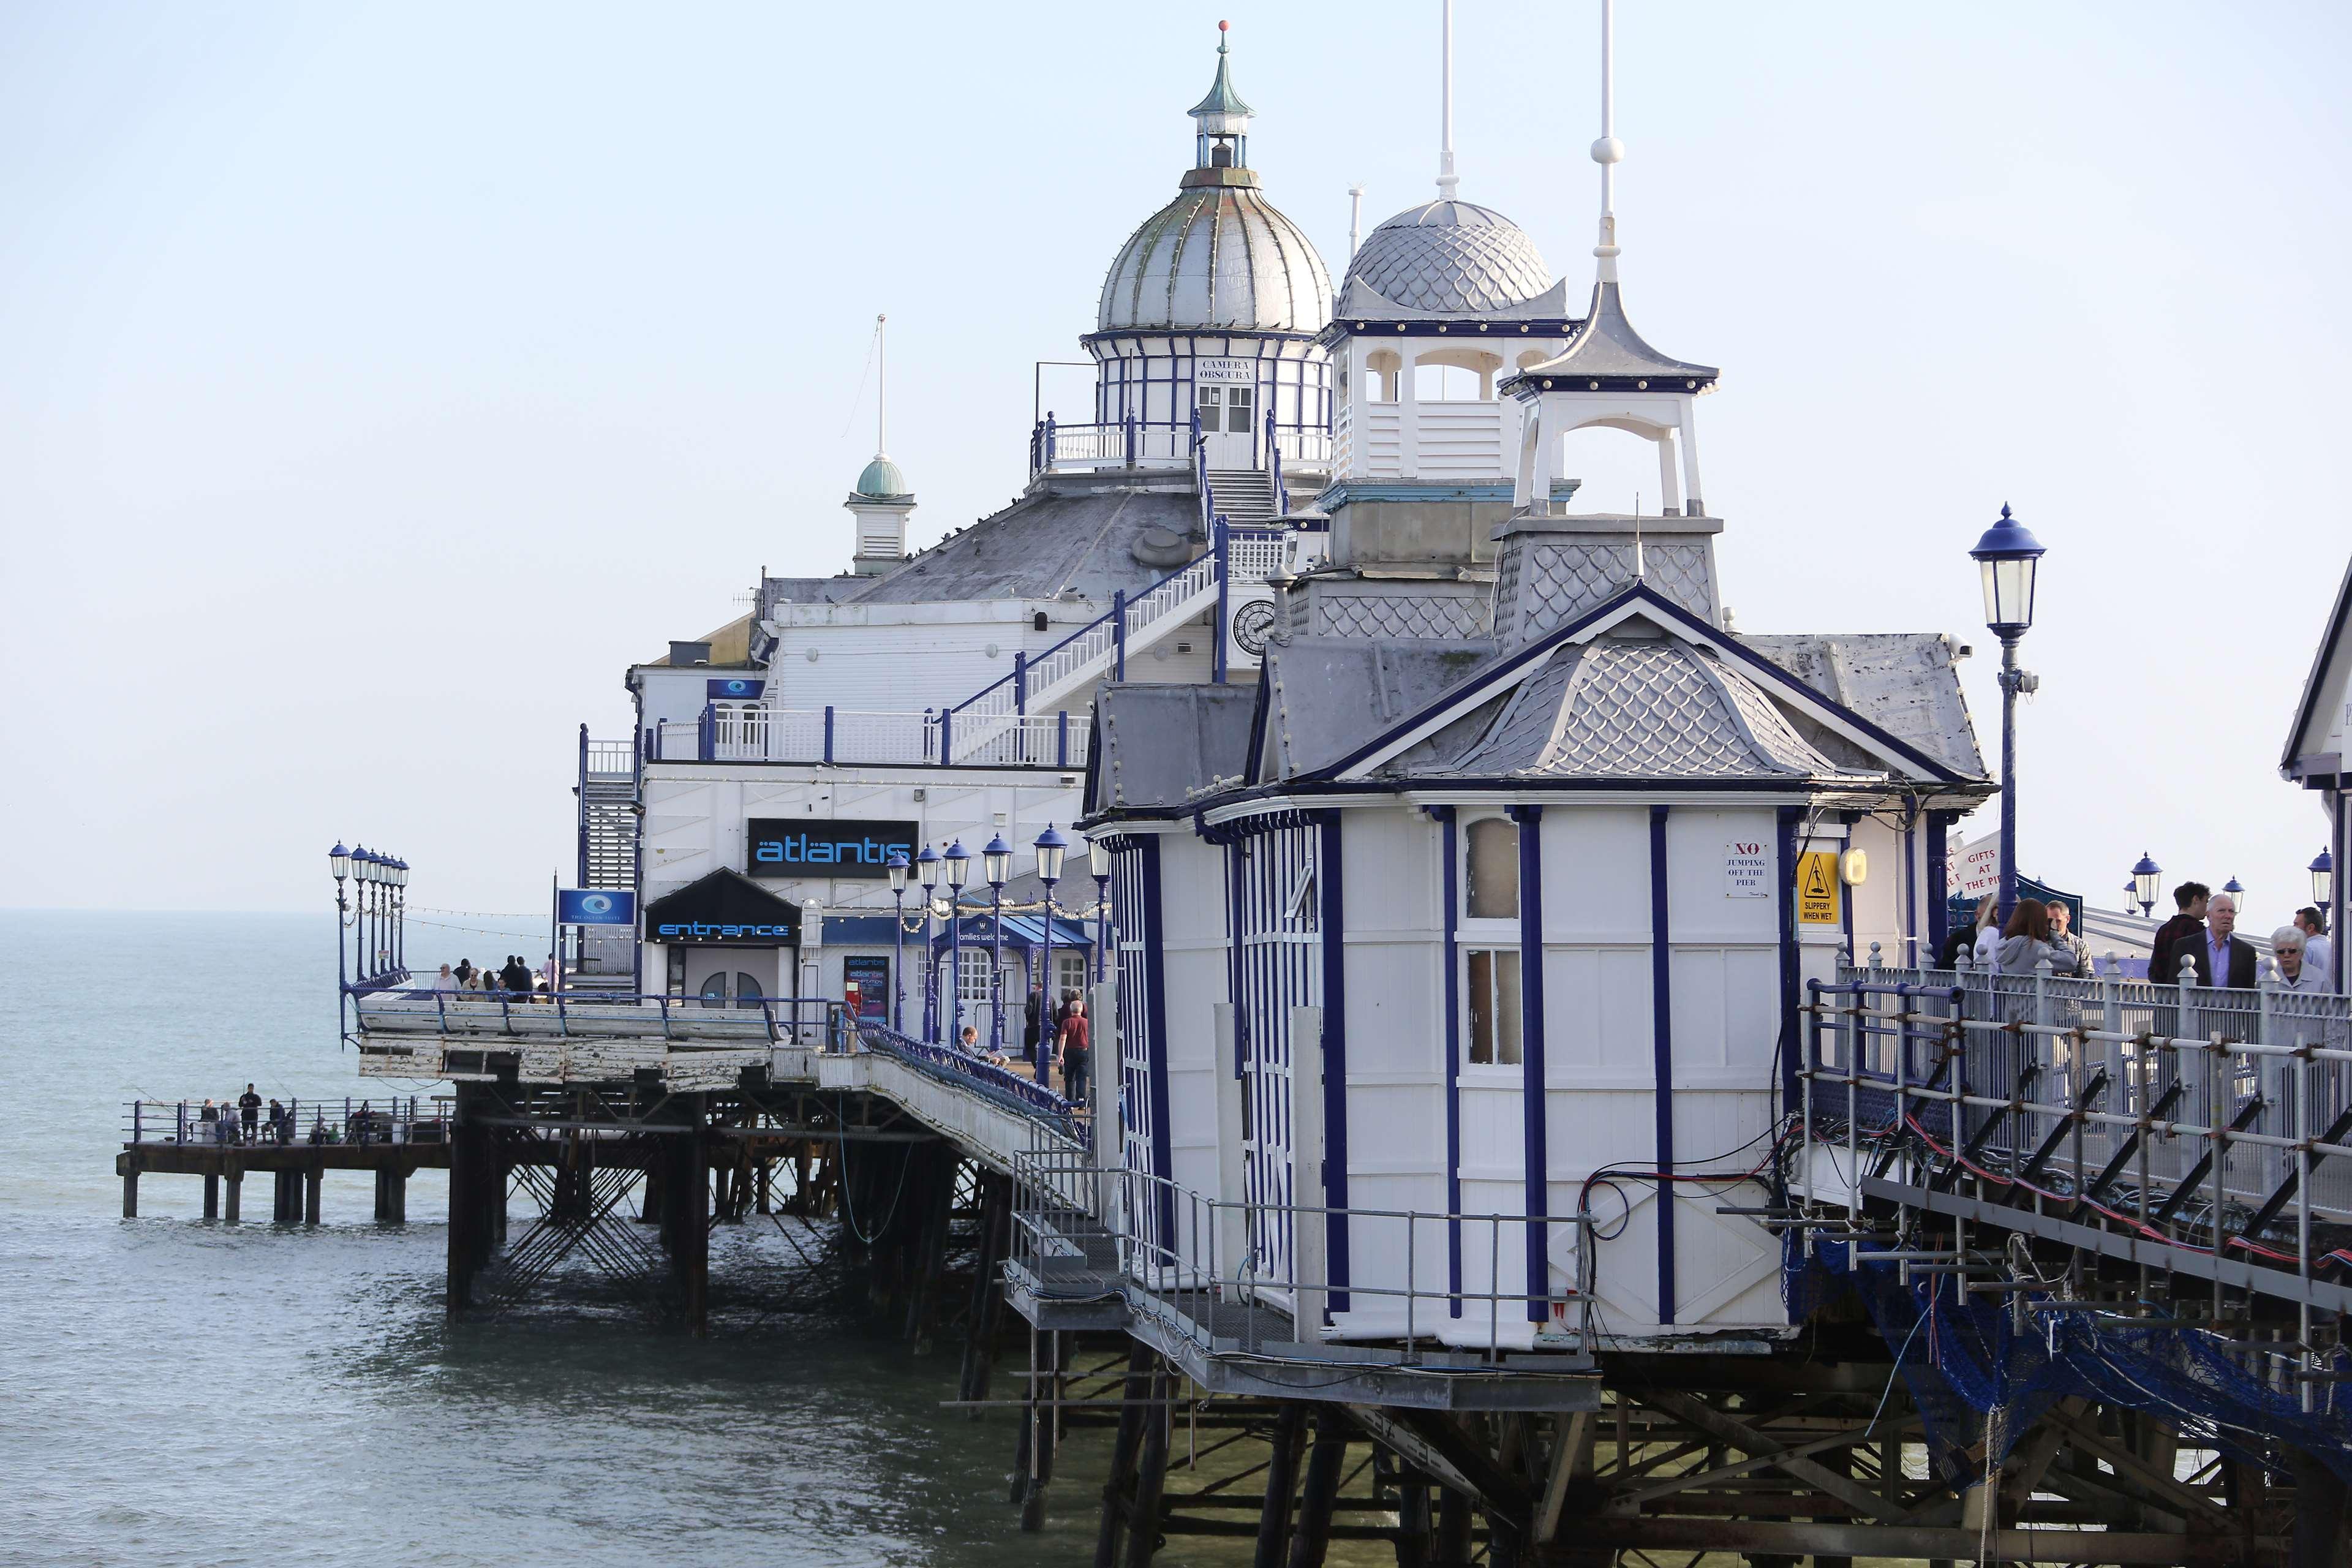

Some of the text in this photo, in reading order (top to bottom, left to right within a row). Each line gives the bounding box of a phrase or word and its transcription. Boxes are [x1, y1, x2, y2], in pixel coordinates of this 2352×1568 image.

[1202, 360, 1250, 369] CAMERA
[1200, 370, 1250, 379] OBSCURA
[756, 833, 911, 863] atlantis
[1734, 843, 1760, 855] NO
[1968, 850, 1995, 863] GIFTS
[1978, 864, 1991, 875] AT
[1966, 880, 1985, 891] THE
[1988, 875, 2000, 886] PI
[1804, 902, 1830, 910] SLIPPERY
[658, 921, 788, 936] entrance
